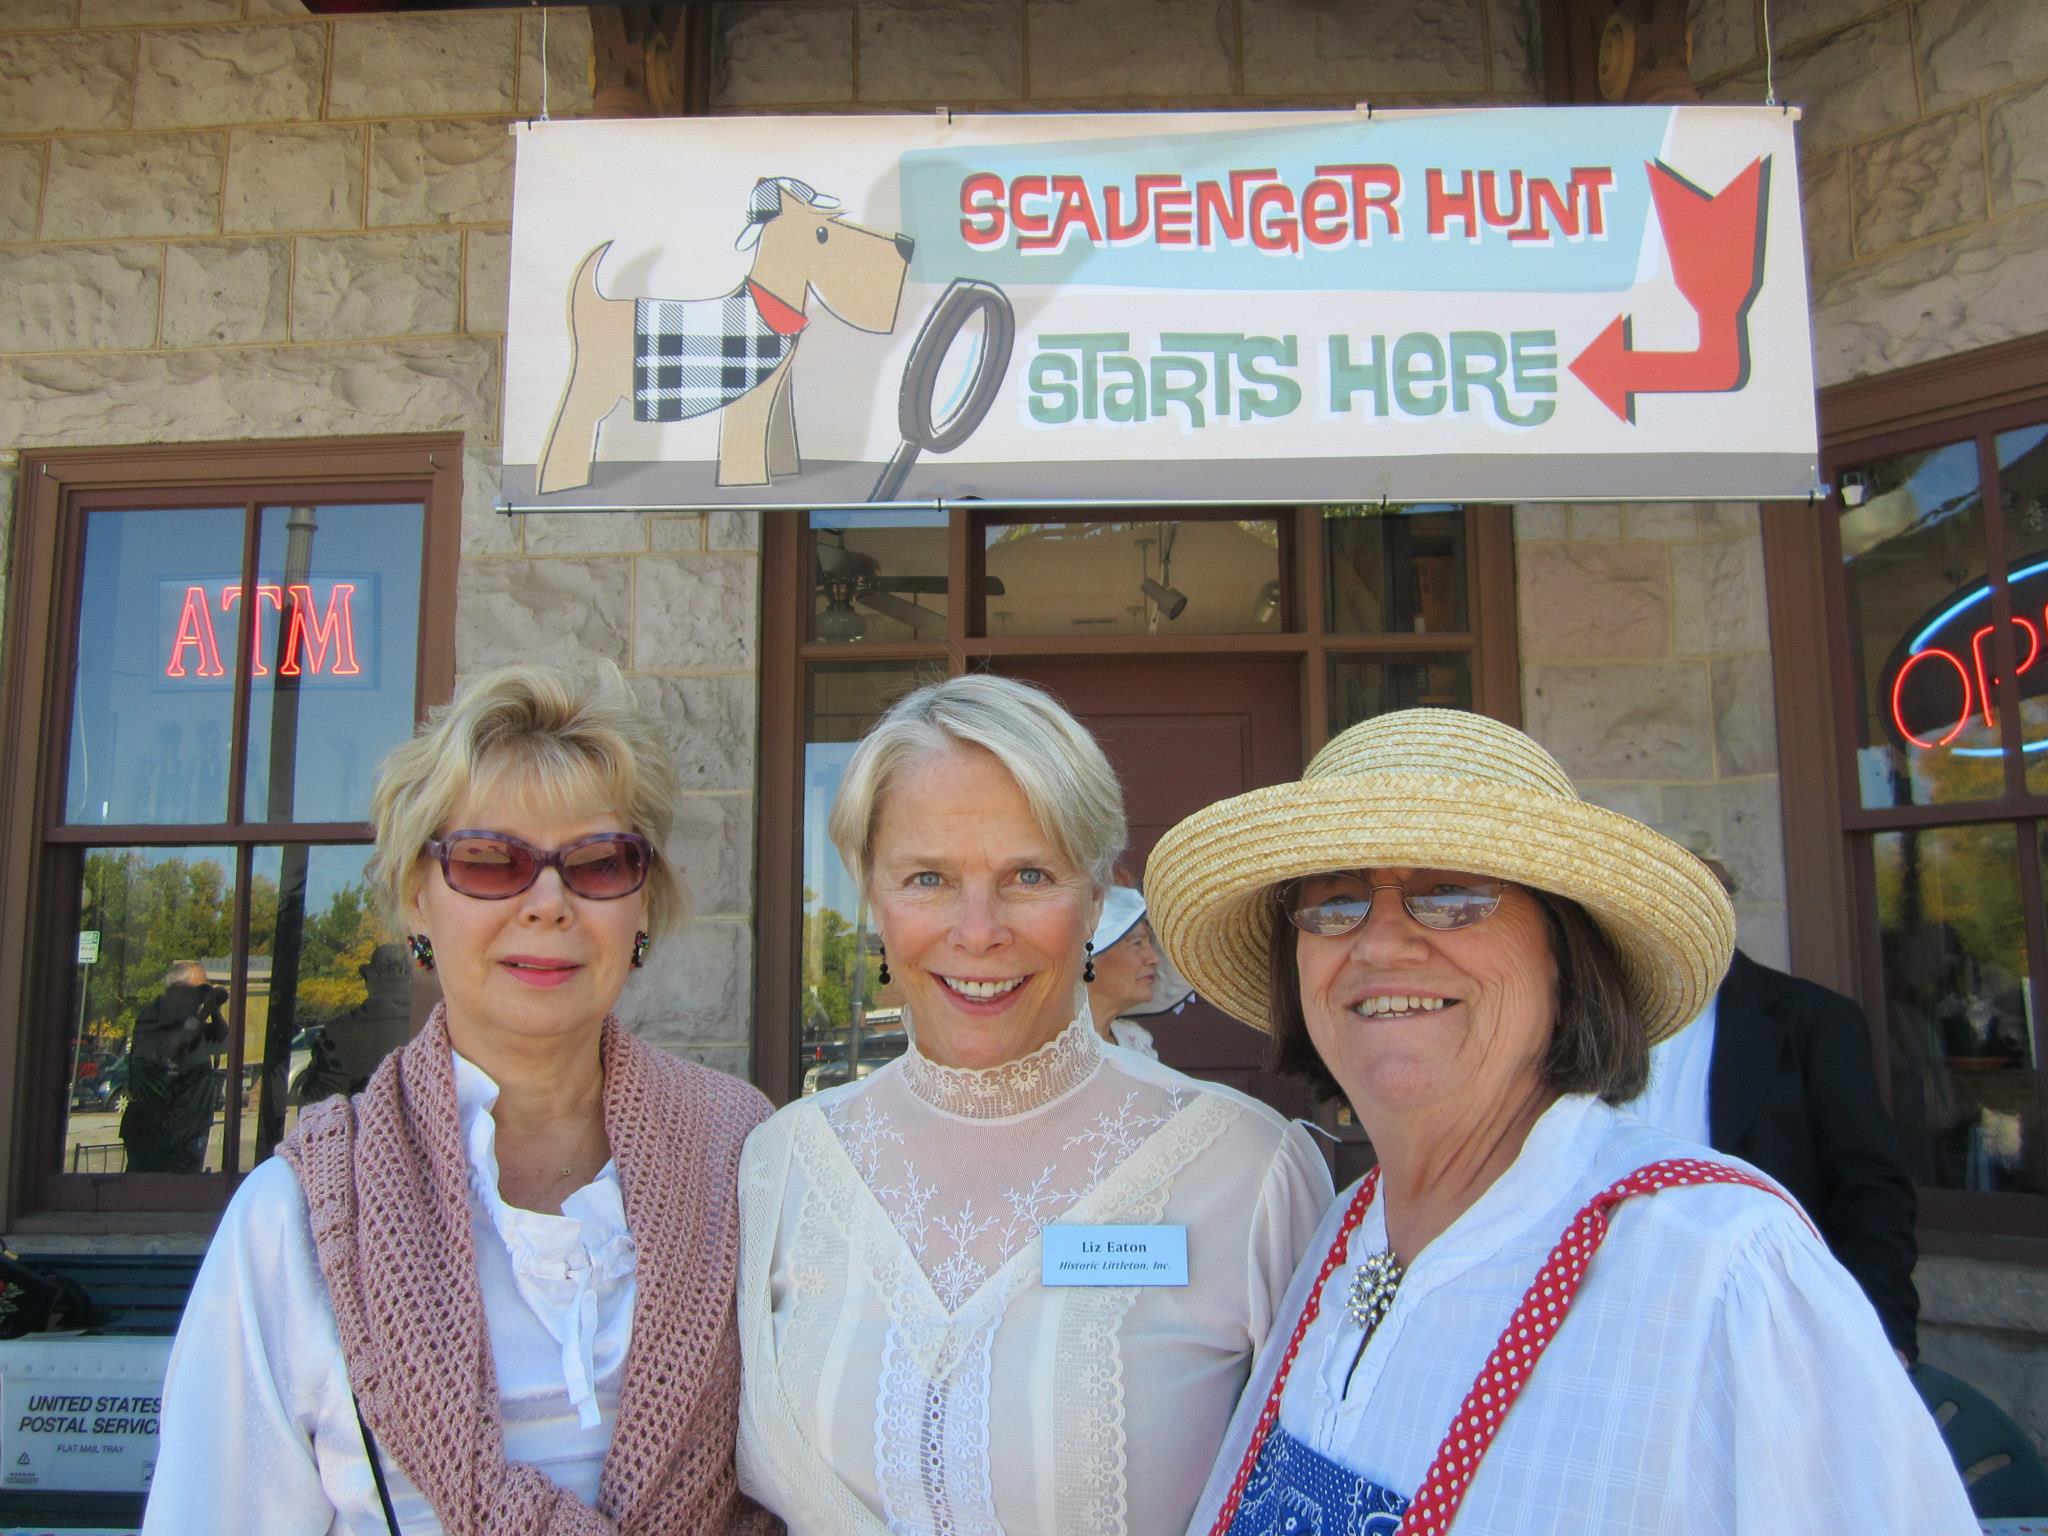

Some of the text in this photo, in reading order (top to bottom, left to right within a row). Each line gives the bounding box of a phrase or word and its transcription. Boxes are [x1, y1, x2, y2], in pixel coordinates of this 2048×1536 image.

[1426, 165, 1614, 242] HUNT
[165, 583, 360, 677] ATM
[1892, 604, 2048, 748] OP
[1082, 1241, 1147, 1253] Liz Eaton
[1059, 1261, 1099, 1270] Historic
[1153, 1261, 1171, 1271] Inc.
[28, 1396, 162, 1413] UNITED STATES
[19, 1416, 88, 1433] POSTAL
[57, 1444, 124, 1454] FLAT MAIL TRAY
